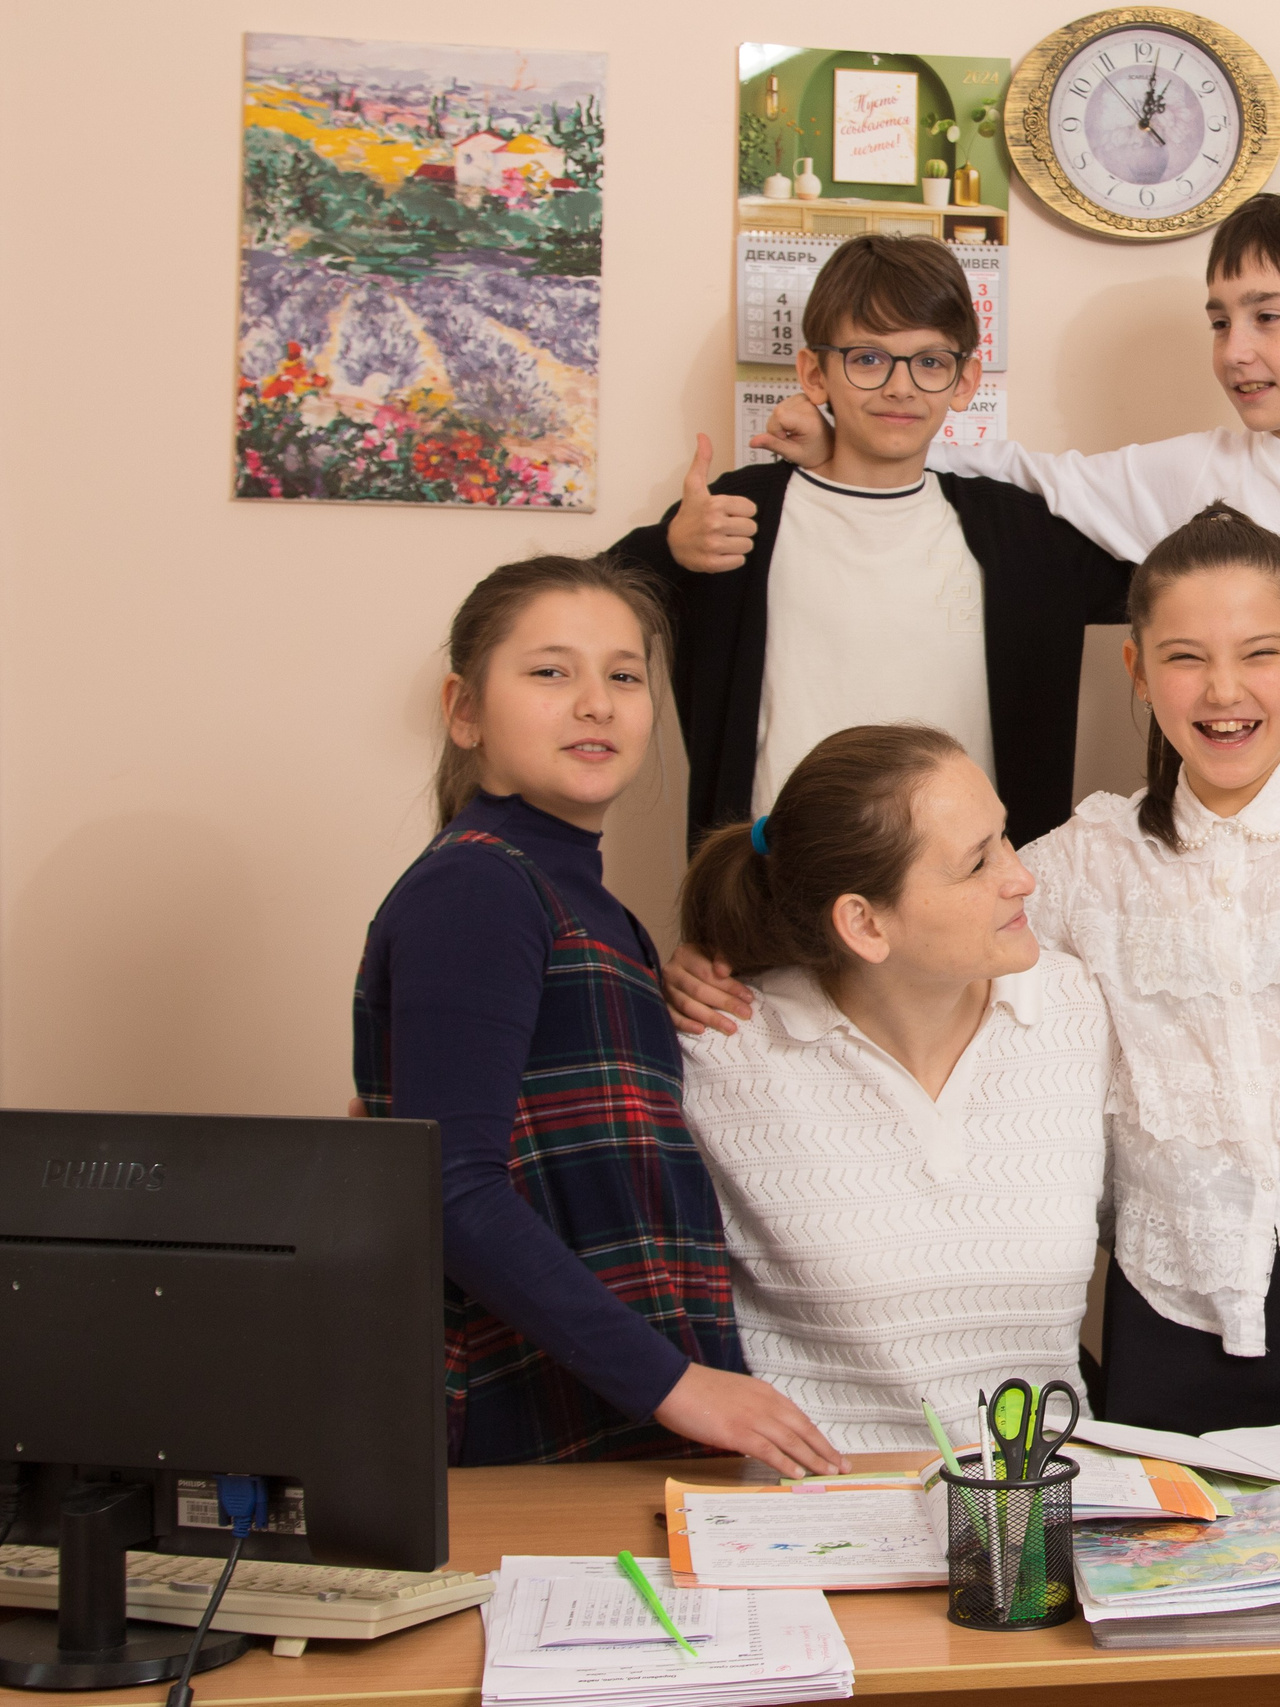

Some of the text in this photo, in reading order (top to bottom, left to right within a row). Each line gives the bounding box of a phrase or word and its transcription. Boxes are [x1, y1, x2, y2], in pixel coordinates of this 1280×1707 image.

[1099, 52, 1115, 72] 11
[1134, 43, 1153, 63] 12
[1173, 53, 1184, 71] 1
[963, 71, 999, 85] 2024
[1069, 78, 1092, 99] 10
[1199, 80, 1216, 98] 2
[855, 95, 898, 120] Пусть
[840, 116, 910, 136] сбываются
[1061, 117, 1081, 132] 9
[1207, 115, 1228, 133] 3
[851, 134, 900, 157] мечты!
[1073, 152, 1092, 170] 8
[1203, 152, 1220, 168] 4
[1107, 174, 1122, 196] 7
[1176, 175, 1194, 196] 5
[1139, 186, 1155, 207] 6
[745, 249, 817, 263] ДЕКАБРЬ
[957, 258, 1000, 270] MBER
[978, 284, 988, 296] 3
[777, 293, 788, 306] 4
[972, 300, 993, 313] 10
[773, 309, 792, 322] 11
[771, 326, 793, 340] 18
[771, 342, 793, 356] 25
[743, 393, 791, 404] ЯНВА
[943, 425, 954, 438] 6
[976, 426, 987, 439] 7
[41, 1159, 165, 1191] PHILIPS
[178, 1479, 207, 1489] PHILIPS
